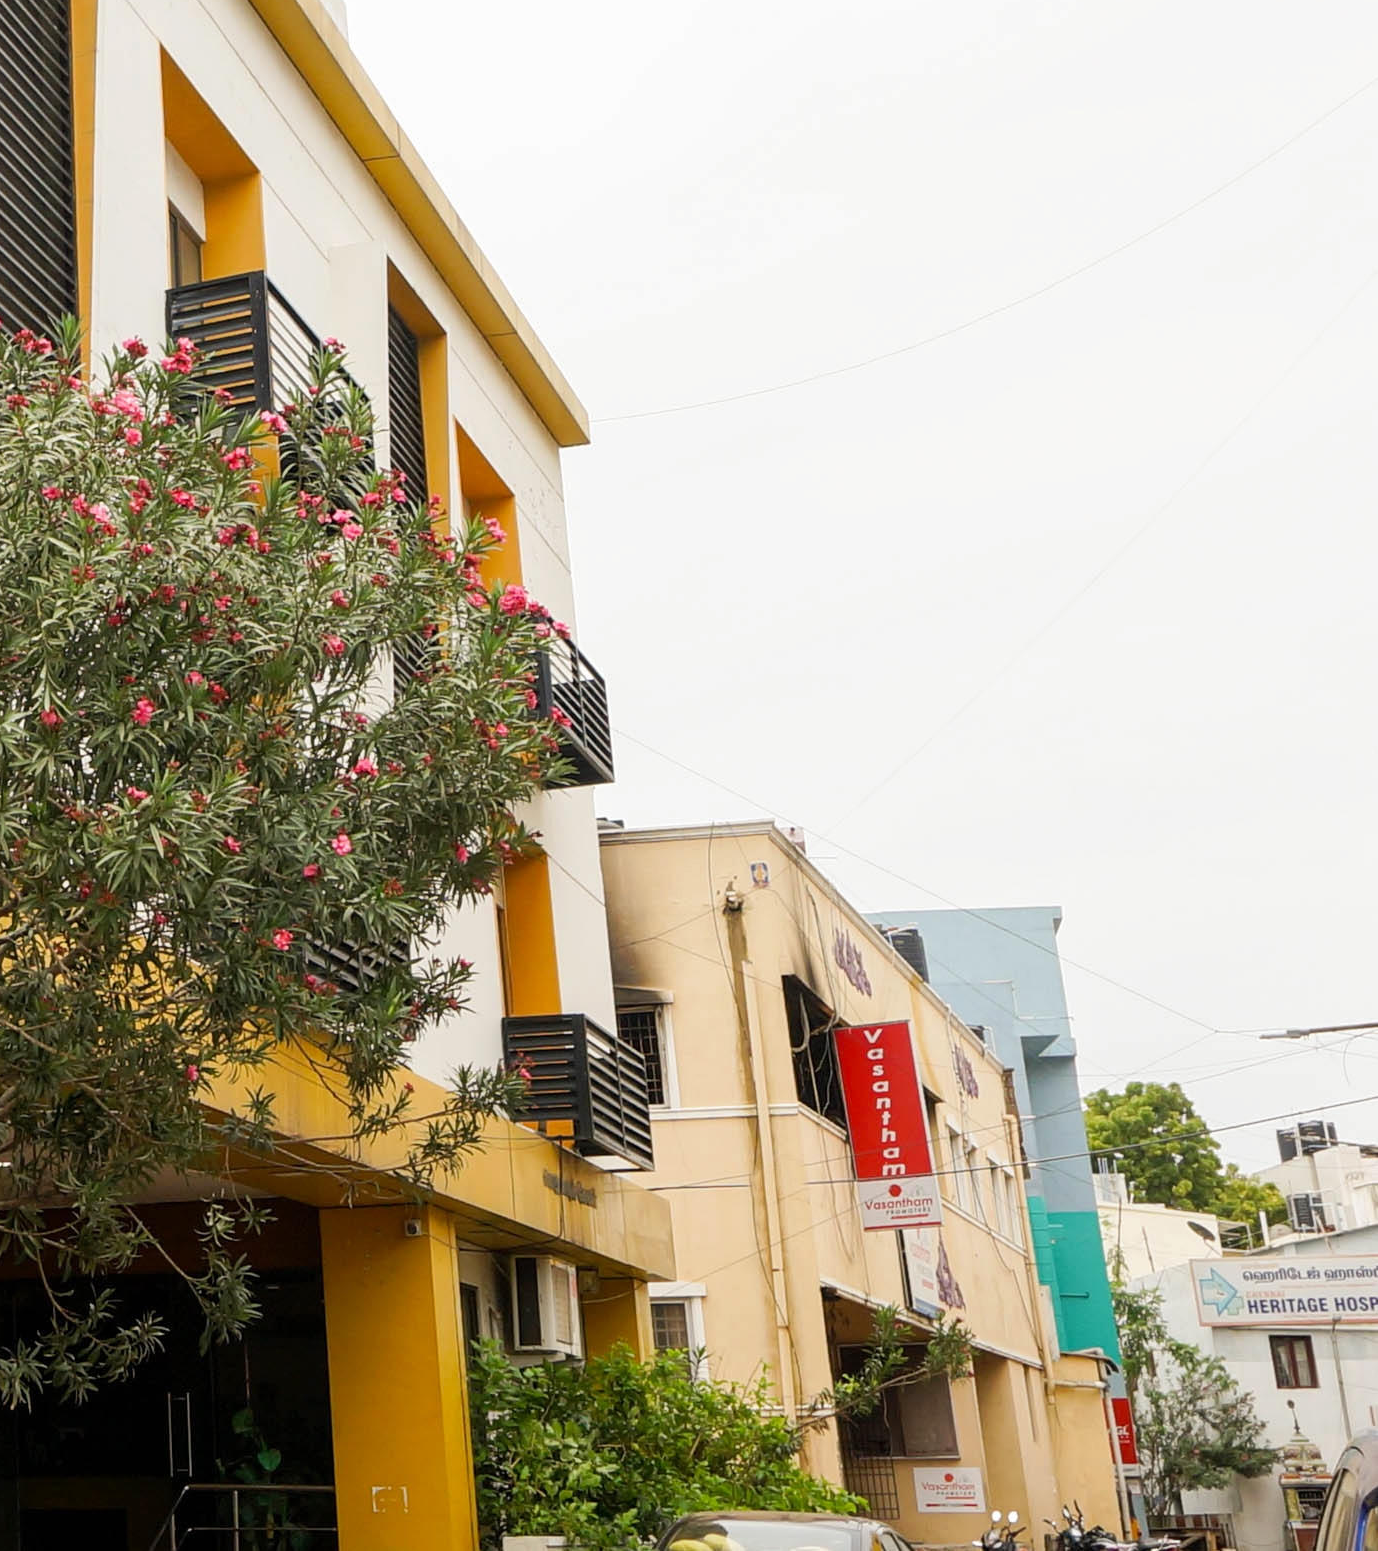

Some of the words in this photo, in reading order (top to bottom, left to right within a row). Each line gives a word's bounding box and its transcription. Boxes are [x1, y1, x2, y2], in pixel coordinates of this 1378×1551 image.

[863, 1028, 907, 1177] Vasantham
[864, 1197, 933, 1211] Vasantham
[1247, 1297, 1329, 1315] HERITAGE
